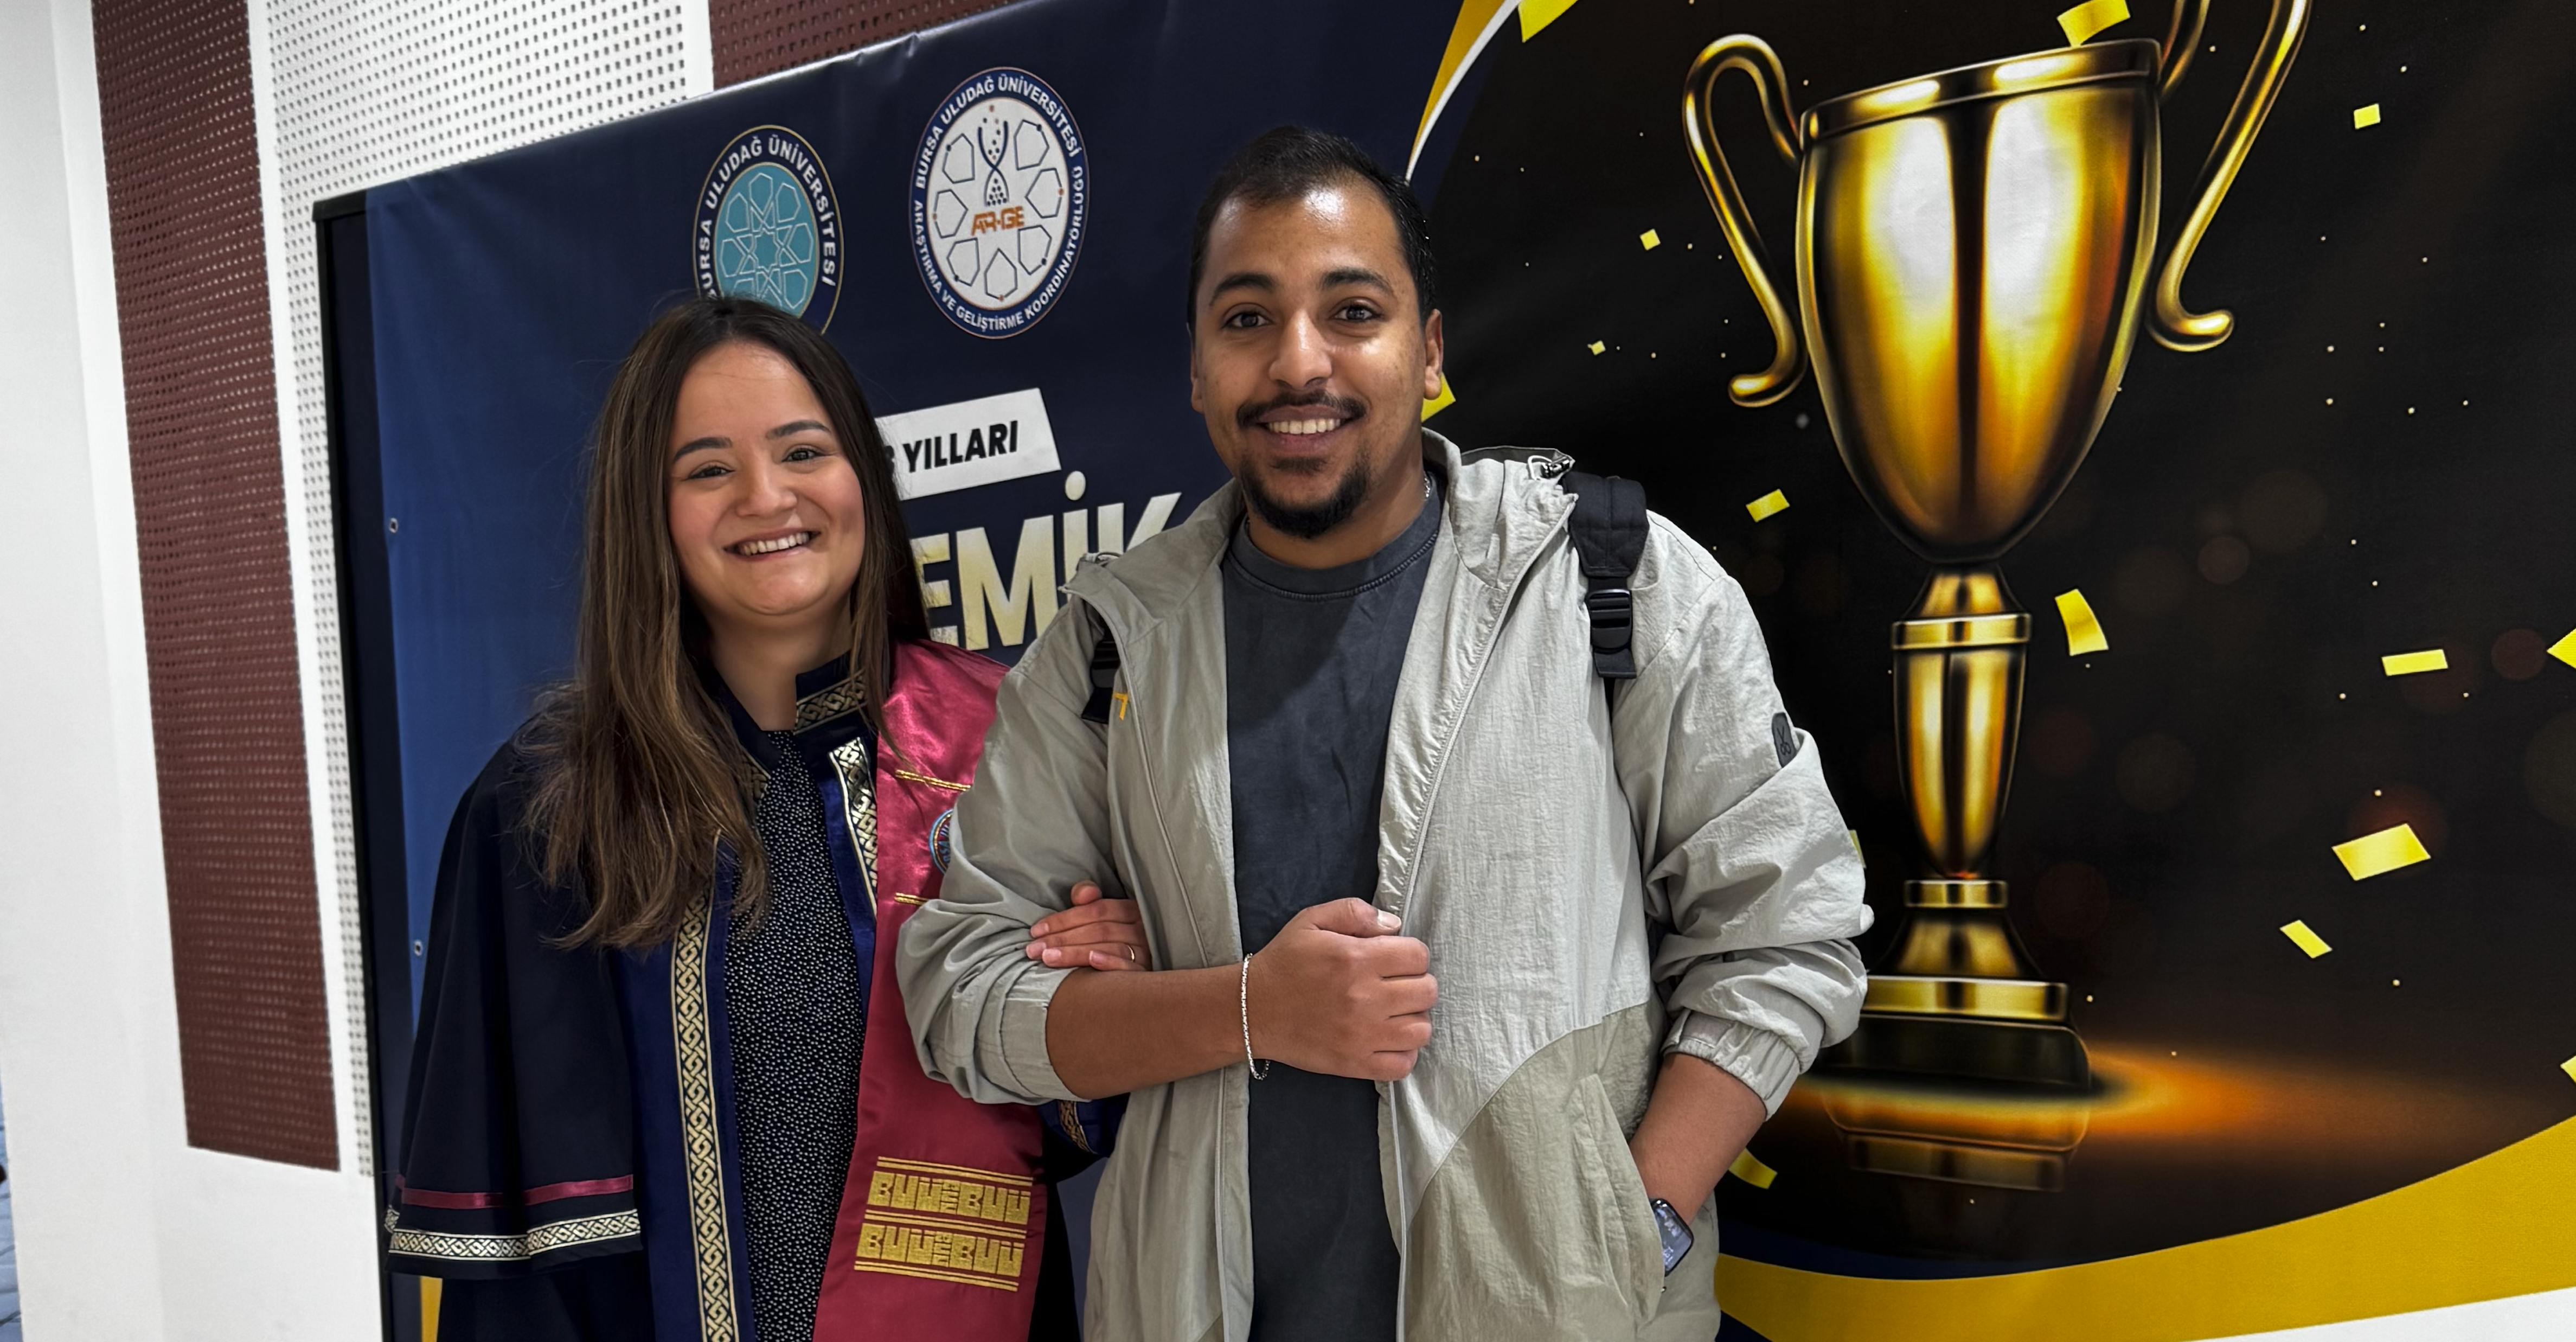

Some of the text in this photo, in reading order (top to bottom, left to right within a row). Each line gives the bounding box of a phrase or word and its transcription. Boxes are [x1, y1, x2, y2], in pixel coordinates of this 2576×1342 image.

[915, 73, 1082, 189] BURSA ULUDAĞ ÜNİVERSİTESİ
[706, 135, 762, 209] ULUDAĞ
[941, 289, 957, 311] VE
[956, 305, 1024, 333] GELİŞTİRME
[902, 420, 1018, 473] YILLARI
